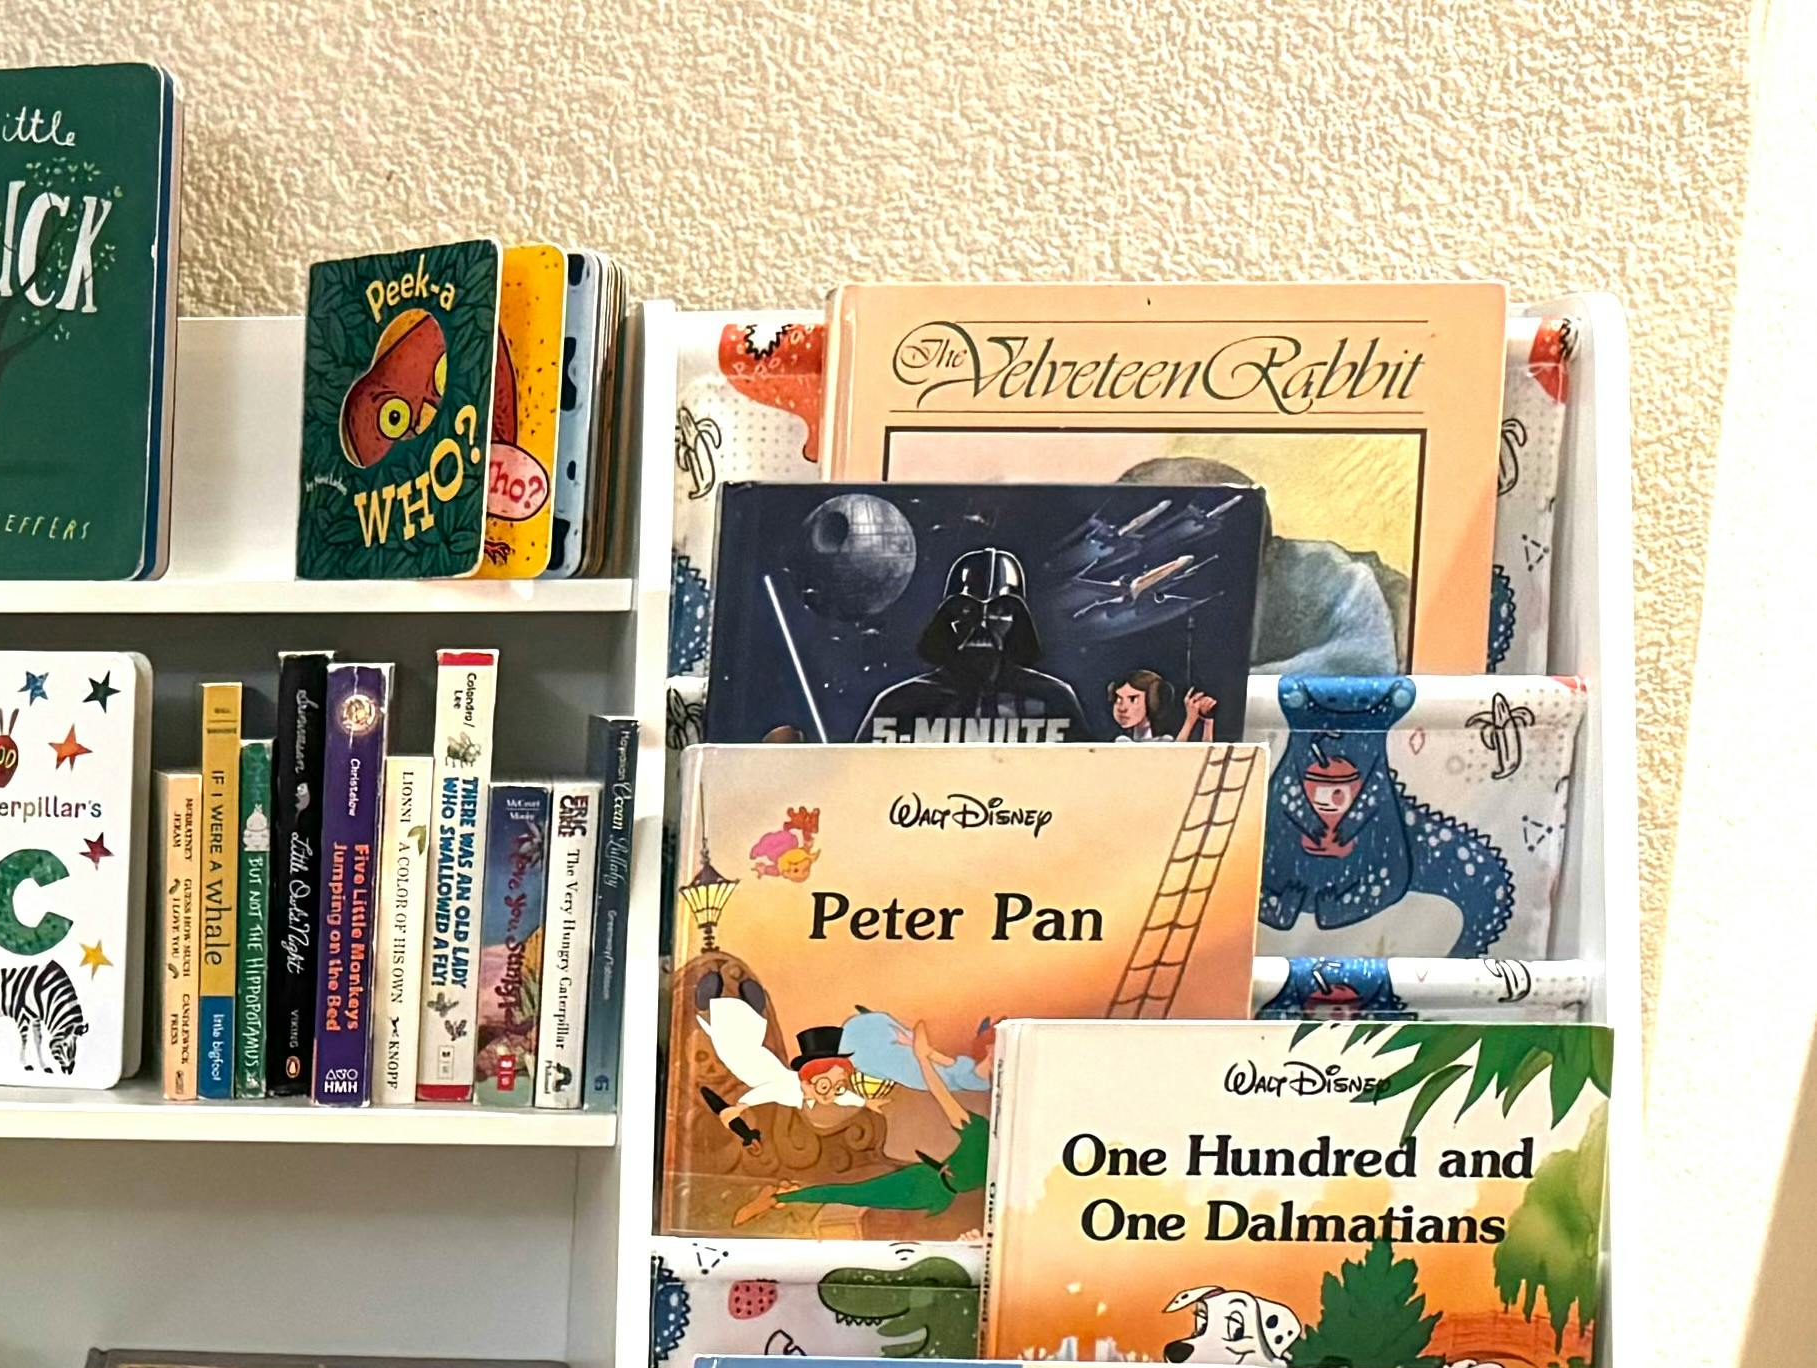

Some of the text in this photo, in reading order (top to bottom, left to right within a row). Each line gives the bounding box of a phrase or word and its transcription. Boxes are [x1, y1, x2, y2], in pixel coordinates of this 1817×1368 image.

[365, 253, 456, 324] Peek-a
[892, 321, 1425, 415] The Velveteen Rabbit
[354, 404, 480, 548] WHO?
[453, 690, 464, 710] Lee
[211, 770, 225, 785] IF
[441, 776, 460, 819] WHO
[210, 804, 224, 854] WERE
[574, 795, 590, 837] ERIC
[209, 860, 223, 872] A
[289, 832, 313, 876] Little
[435, 824, 456, 933] SWALLOWED
[451, 776, 479, 990] THERE WAS AN OLD LADY
[204, 879, 232, 966] Whale
[326, 841, 348, 1032] Jumping on the Bed
[346, 843, 370, 1031] Five Little Monkeys
[386, 771, 414, 1090] LIONNI A COLOR OF HIS OWN KNOPF
[809, 892, 1104, 942] Peter Pan
[242, 857, 265, 1068] BUT NOT THE HIPPOPOTAMUS
[281, 922, 311, 975] Night
[433, 936, 449, 950] A
[553, 848, 580, 1049] The Very Hungry Caterpillar
[289, 1010, 300, 1048] VIKING
[324, 1081, 358, 1094] HMH
[1062, 1134, 1534, 1179] One Hundred and
[1081, 1199, 1506, 1244] One Dalmatians
